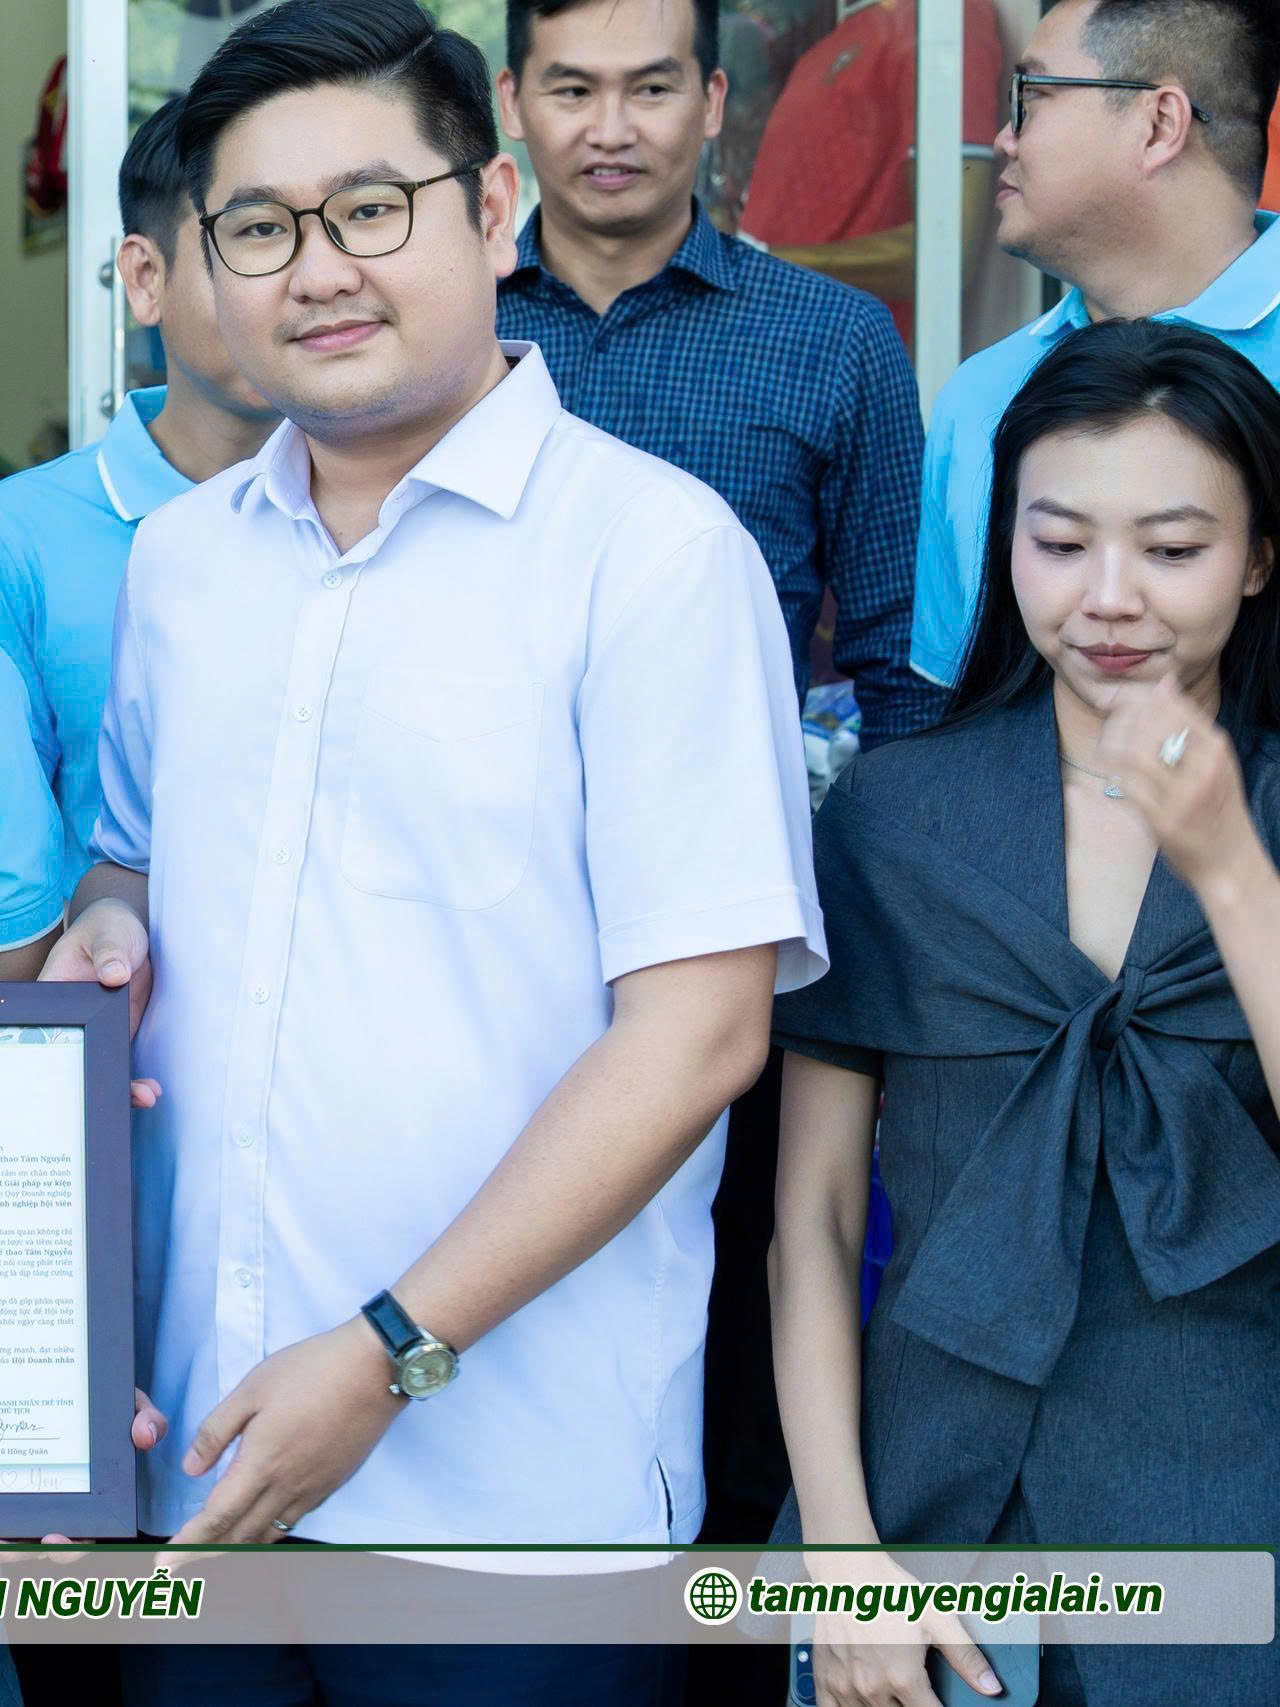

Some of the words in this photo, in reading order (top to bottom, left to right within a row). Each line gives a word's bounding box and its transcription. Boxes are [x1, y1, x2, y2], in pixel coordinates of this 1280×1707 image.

[21, 1154, 38, 1162] Tâm
[40, 1153, 72, 1165] Nguyễn
[4, 1178, 19, 1186] Giải
[22, 1178, 40, 1189] pháp
[54, 1178, 72, 1189] kiện
